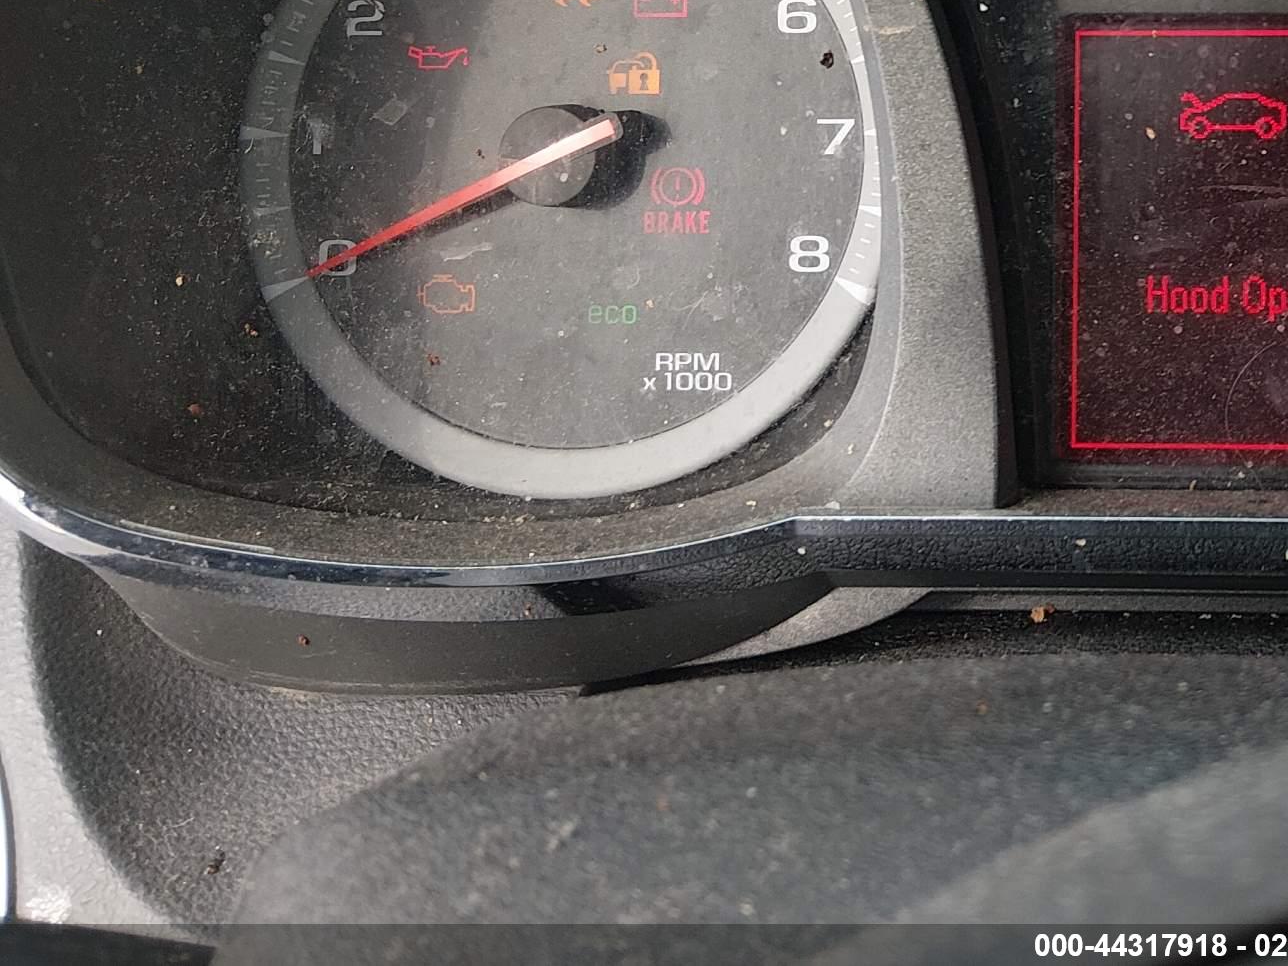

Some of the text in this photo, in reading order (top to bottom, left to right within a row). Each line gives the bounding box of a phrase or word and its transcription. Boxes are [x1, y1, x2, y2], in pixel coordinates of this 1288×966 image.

[346, 0, 384, 36] 2
[306, 118, 322, 155] 1
[816, 118, 855, 155] 7
[643, 211, 711, 234] BRAKE
[318, 239, 357, 276] 0
[788, 236, 830, 272] 8
[1145, 275, 1229, 315] Hood
[588, 304, 638, 325] eco
[654, 352, 721, 372] RPM
